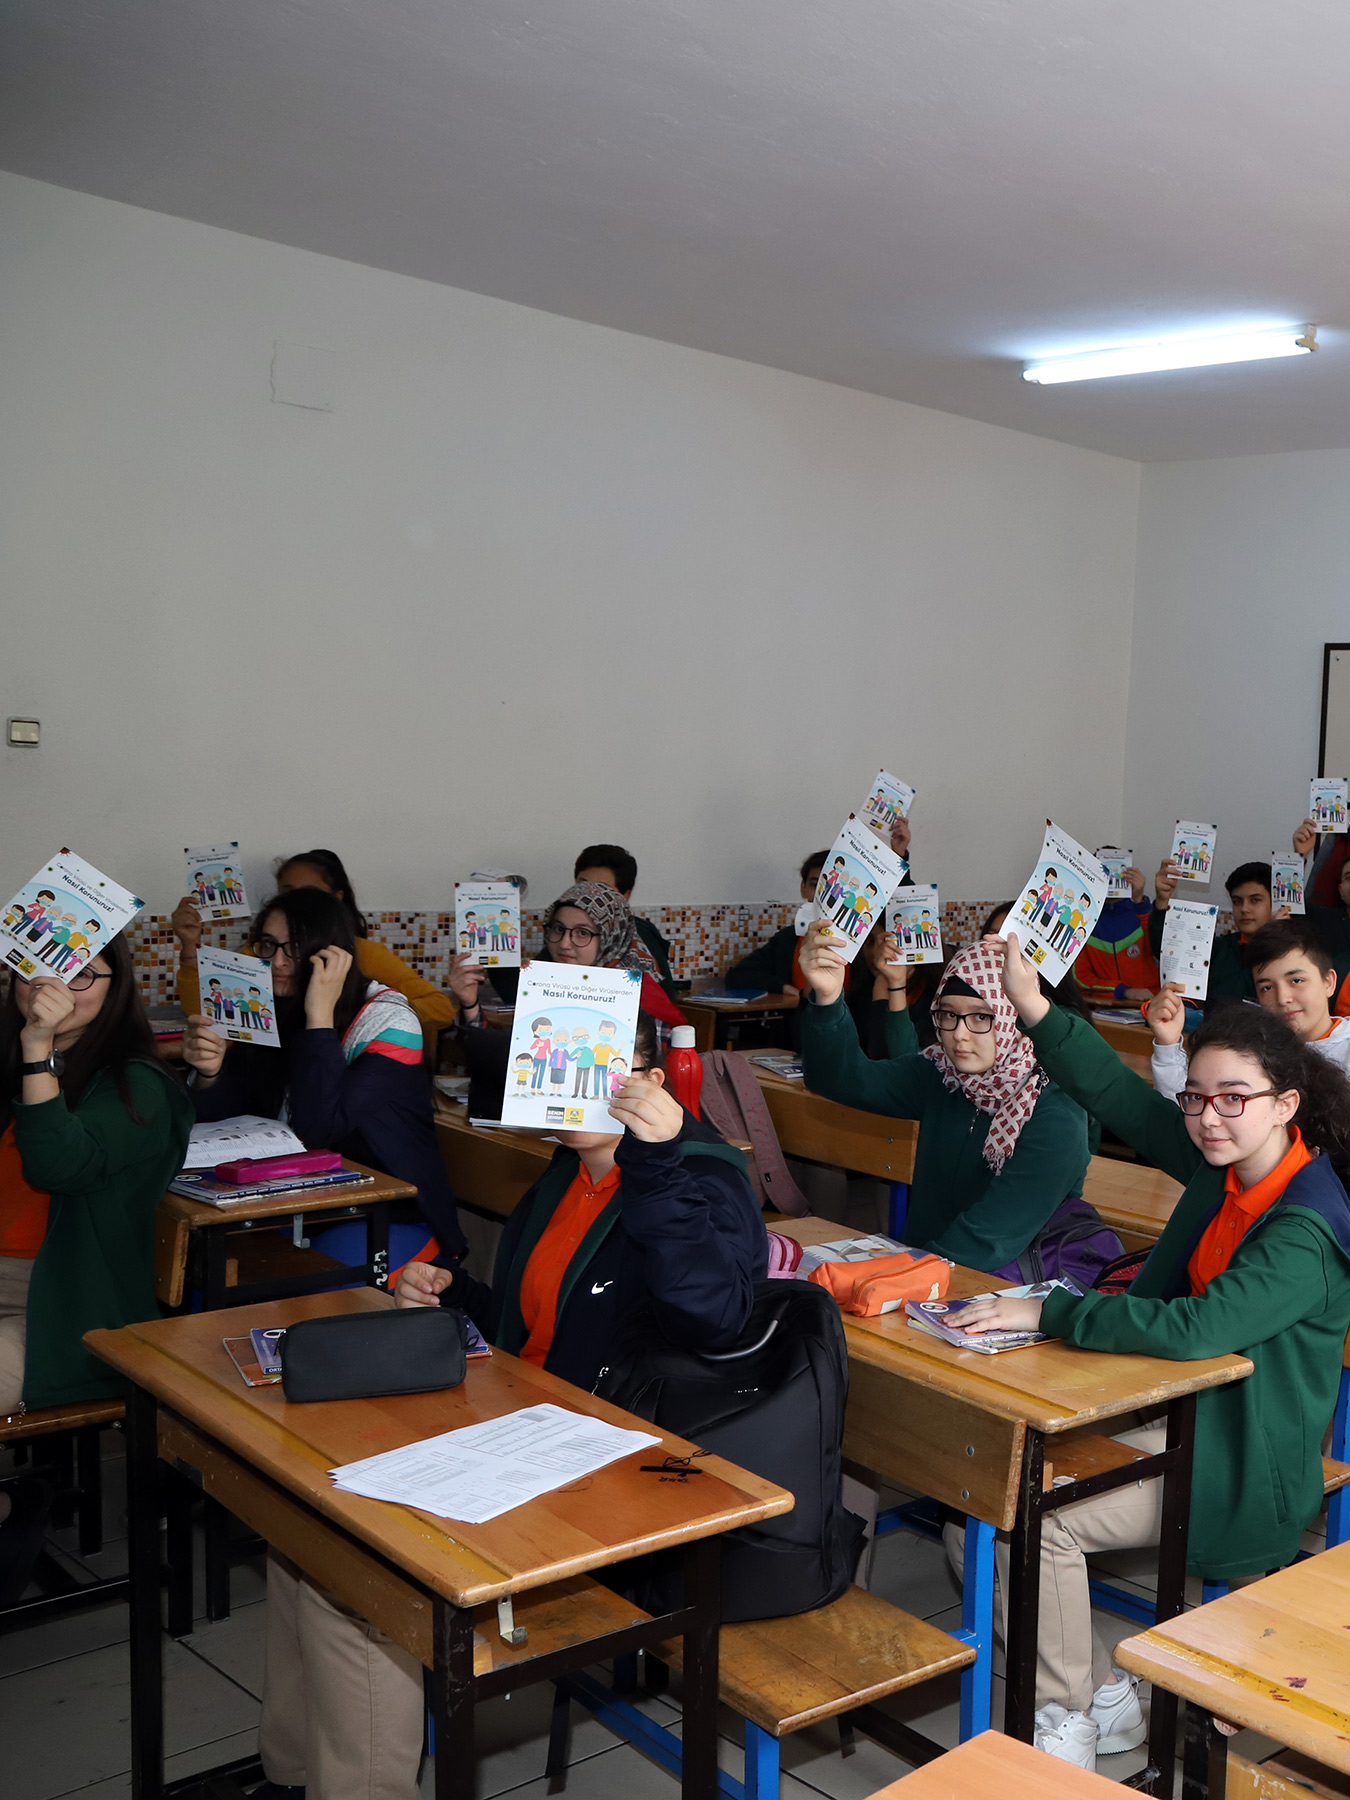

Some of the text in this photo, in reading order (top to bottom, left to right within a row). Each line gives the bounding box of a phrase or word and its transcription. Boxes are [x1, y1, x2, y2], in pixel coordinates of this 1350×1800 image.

[62, 874, 80, 889] Nasıl
[543, 989, 615, 1003] Nasıl Korunuruz!
